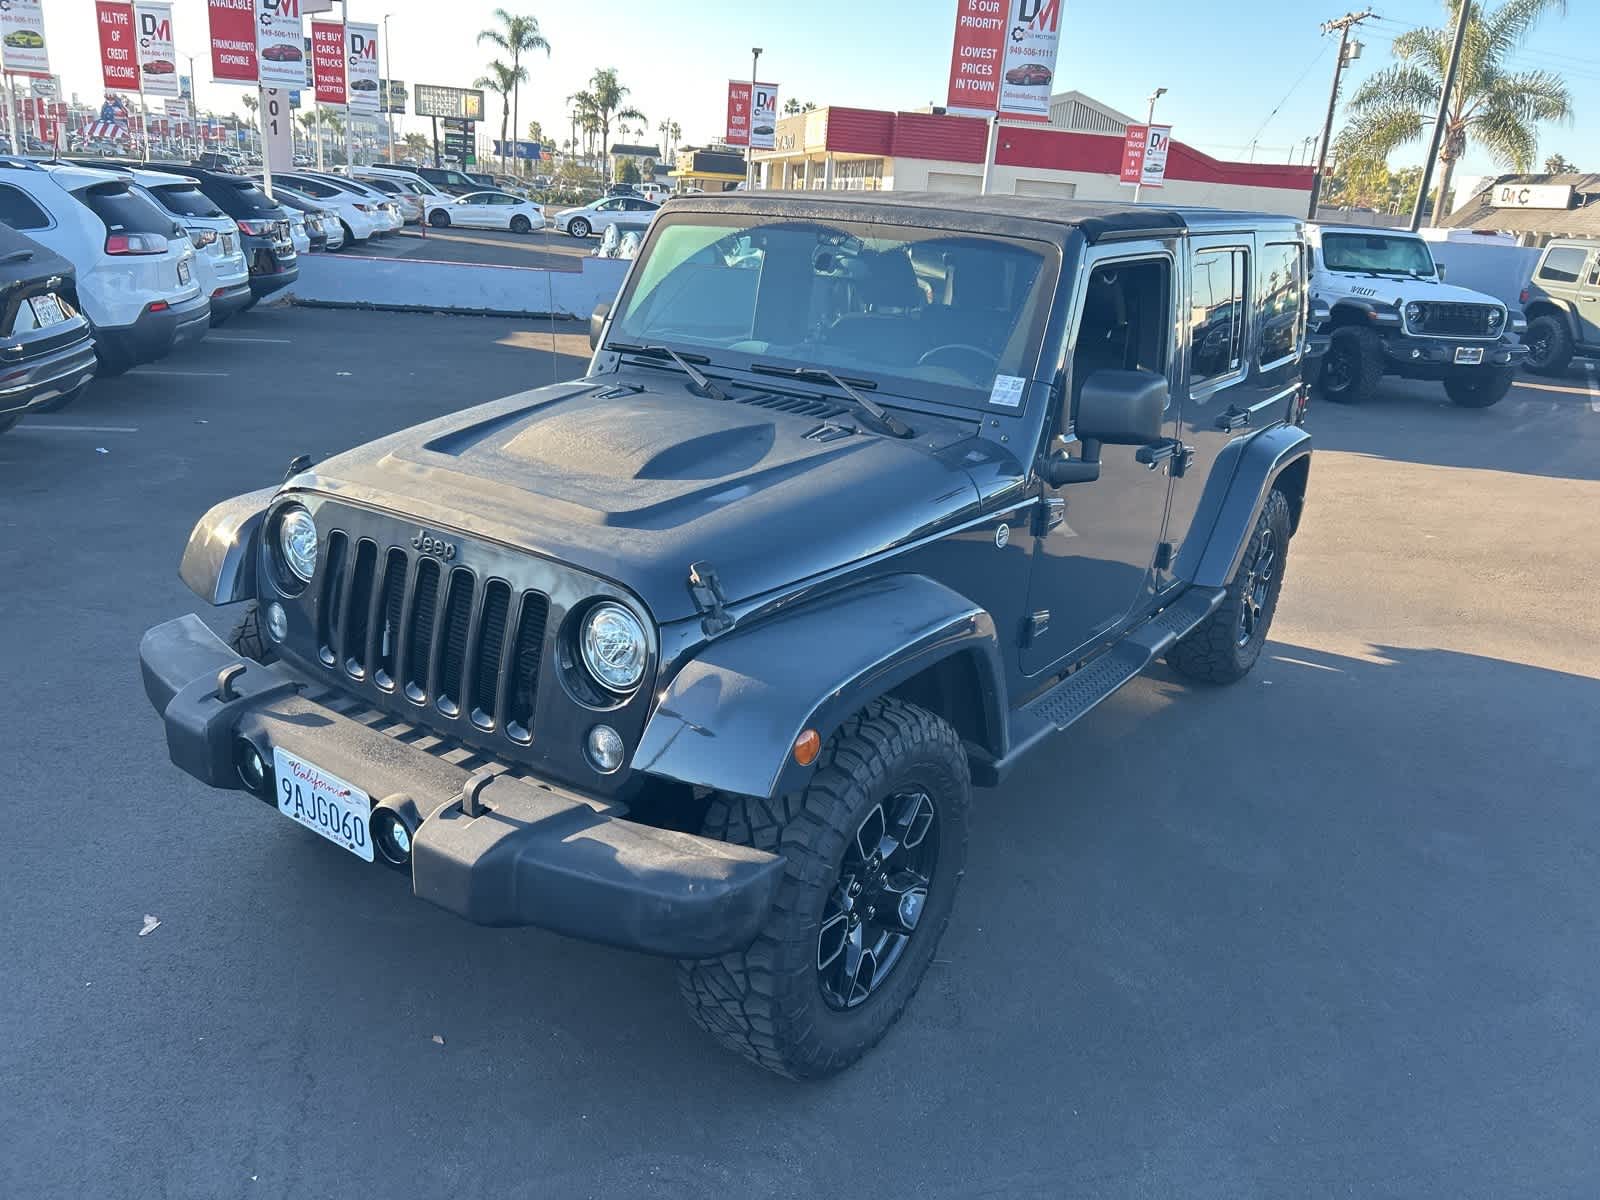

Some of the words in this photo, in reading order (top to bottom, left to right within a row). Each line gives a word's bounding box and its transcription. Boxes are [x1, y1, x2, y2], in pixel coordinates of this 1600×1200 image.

[968, 0, 977, 10] IS
[979, 0, 999, 12] OUR
[100, 11, 112, 24] ALL
[112, 13, 128, 24] TYPE
[961, 15, 1003, 30] PRIORITY
[111, 30, 120, 41] OF
[315, 31, 326, 41] WE
[327, 32, 342, 42] BUY
[106, 48, 128, 60] CREDIT
[316, 44, 335, 54] CARS
[336, 46, 341, 55] &
[960, 46, 997, 60] LOWEST
[220, 54, 249, 66] DISPONIBLE
[316, 57, 343, 68] TRUCKS
[104, 65, 135, 79] WELCOME
[961, 62, 993, 75] PRICES
[317, 85, 344, 94] ACCEPTED
[956, 79, 966, 89] IN
[967, 80, 994, 92] TOWN
[410, 530, 456, 564] Jeep
[293, 762, 347, 797] California
[282, 778, 366, 848] 9AJG060
